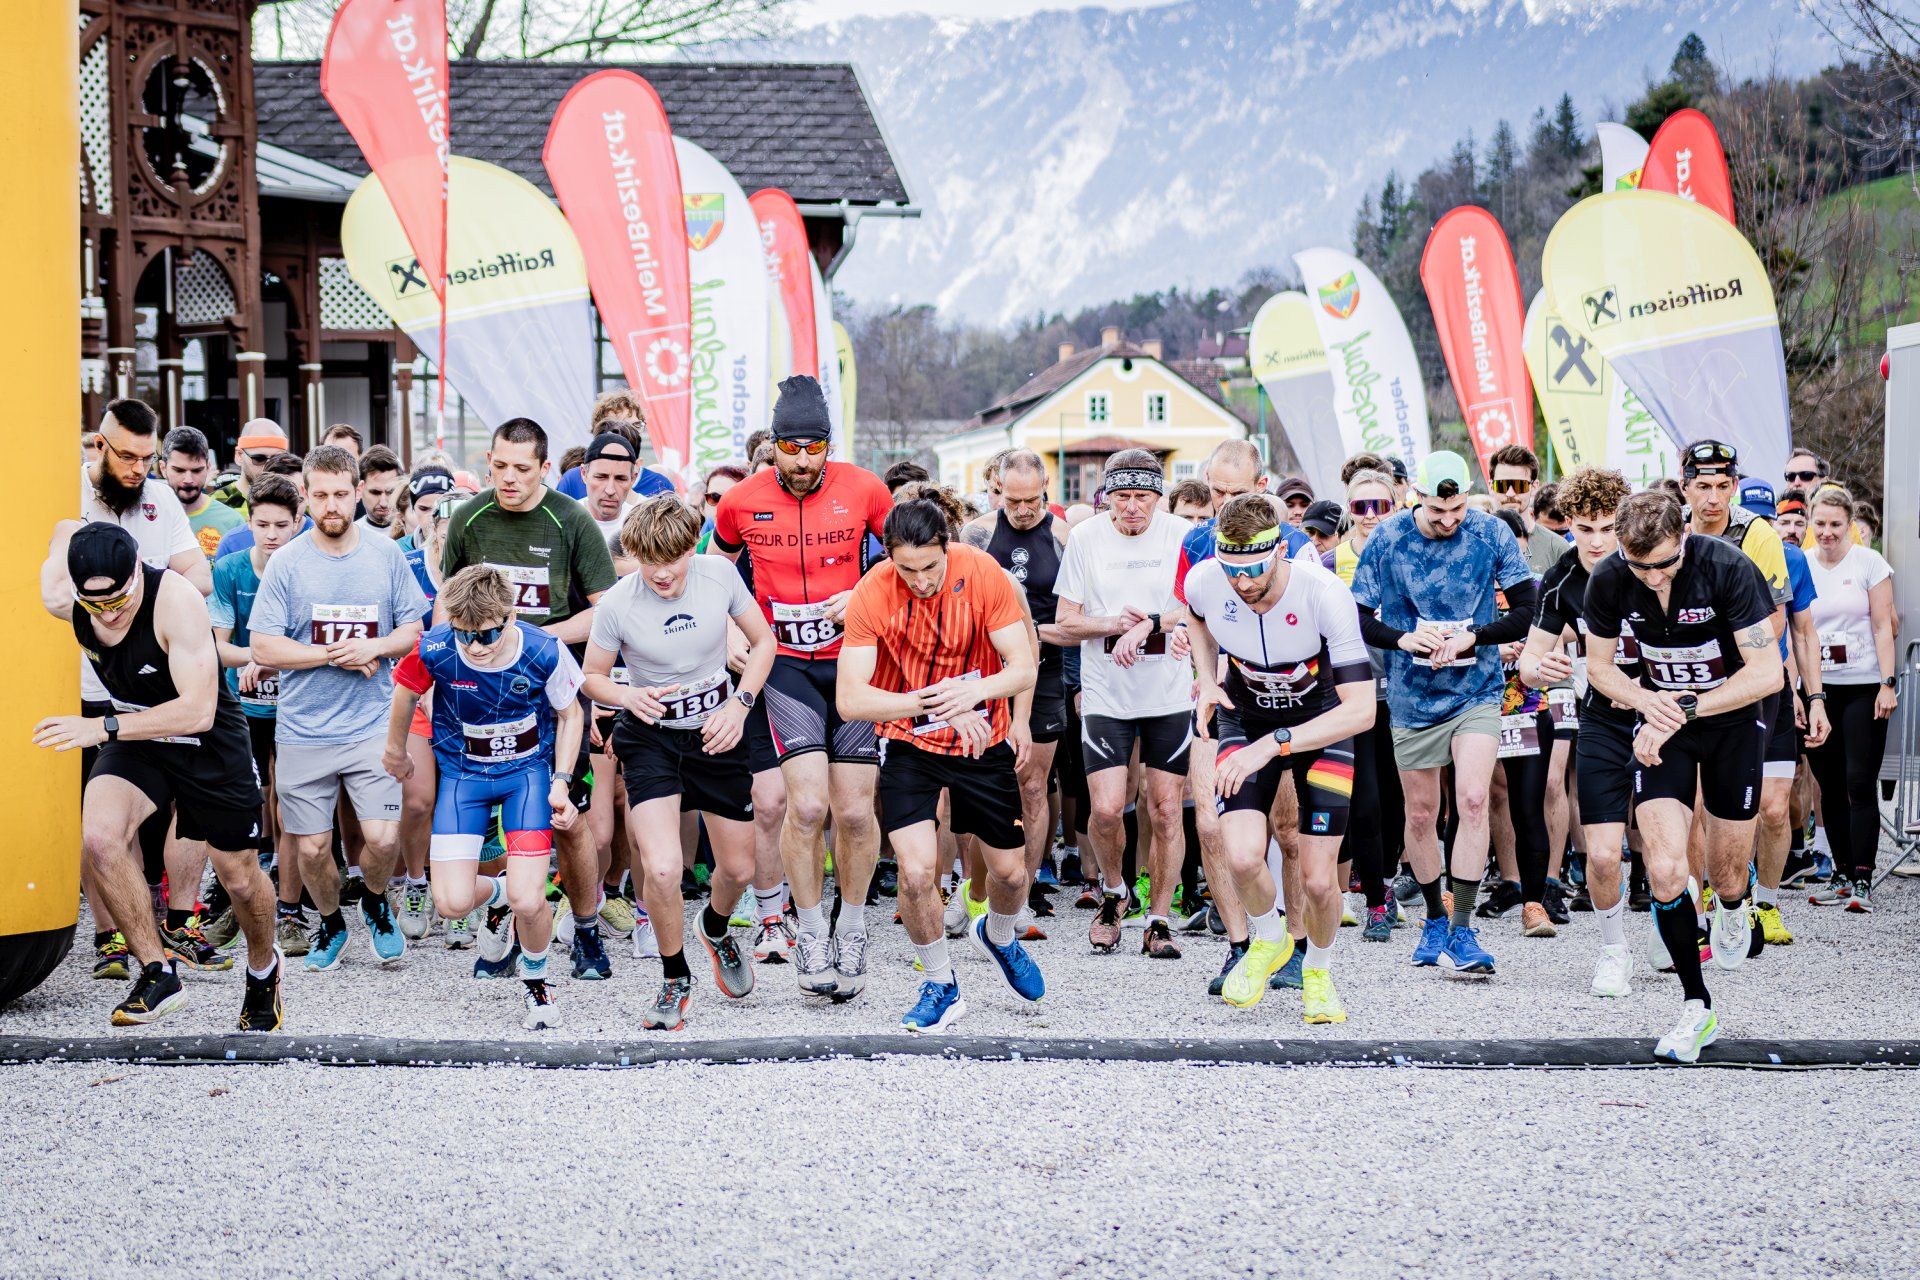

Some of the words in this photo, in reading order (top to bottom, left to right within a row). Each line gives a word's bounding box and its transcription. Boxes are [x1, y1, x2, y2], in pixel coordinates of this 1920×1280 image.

[749, 533, 784, 546] TOUR
[818, 528, 855, 545] HERZ
[321, 622, 368, 645] 173
[664, 621, 697, 635] skinfit
[785, 619, 836, 644] 168
[1655, 663, 1713, 683] 153
[1263, 682, 1292, 690] 84
[670, 688, 720, 719] 130
[489, 735, 518, 750] 68
[491, 748, 516, 757] Felix
[1743, 786, 1753, 810] FUSION
